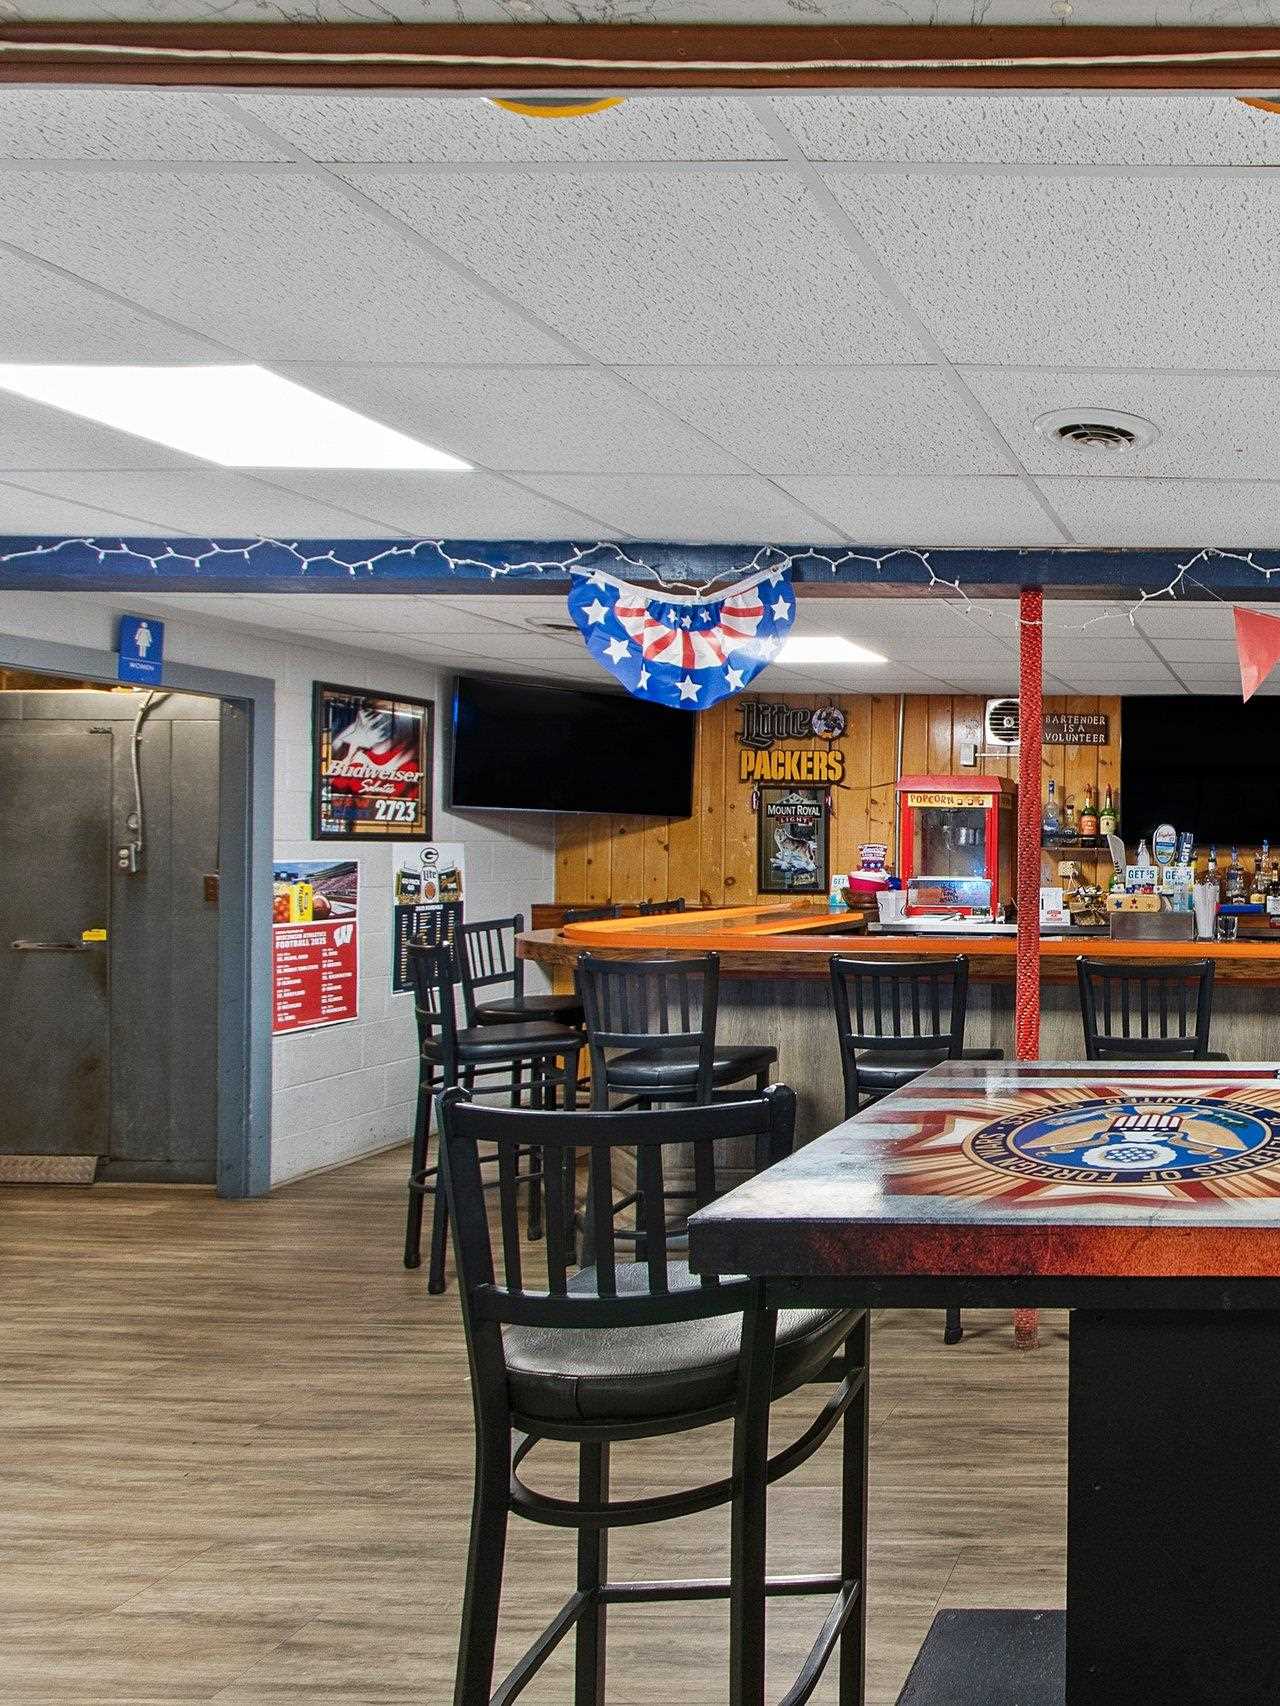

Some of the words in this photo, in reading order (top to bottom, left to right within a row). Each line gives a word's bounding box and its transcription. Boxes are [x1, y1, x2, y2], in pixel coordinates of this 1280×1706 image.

[739, 702, 811, 748] Lite
[1045, 714, 1106, 725] BARTENDER
[1063, 724, 1074, 732] IS
[1078, 724, 1085, 732] A
[1045, 733, 1105, 743] VOLUNTEER
[329, 760, 424, 782] Budweiser
[740, 750, 843, 781] PACKERS
[910, 795, 954, 804] POPCORN
[375, 800, 417, 822] 2723
[767, 804, 796, 816] MOUNT
[797, 804, 821, 816] ROYAL
[1128, 869, 1144, 879] GET
[1146, 869, 1155, 879] $5
[275, 939, 310, 949] FOOTBALL
[1001, 1102, 1083, 1126] STATES
[1222, 1101, 1265, 1114] THE
[973, 1133, 1011, 1160] WARS
[995, 1156, 1118, 1183] FOREIGN
[1141, 1169, 1183, 1182] OF
